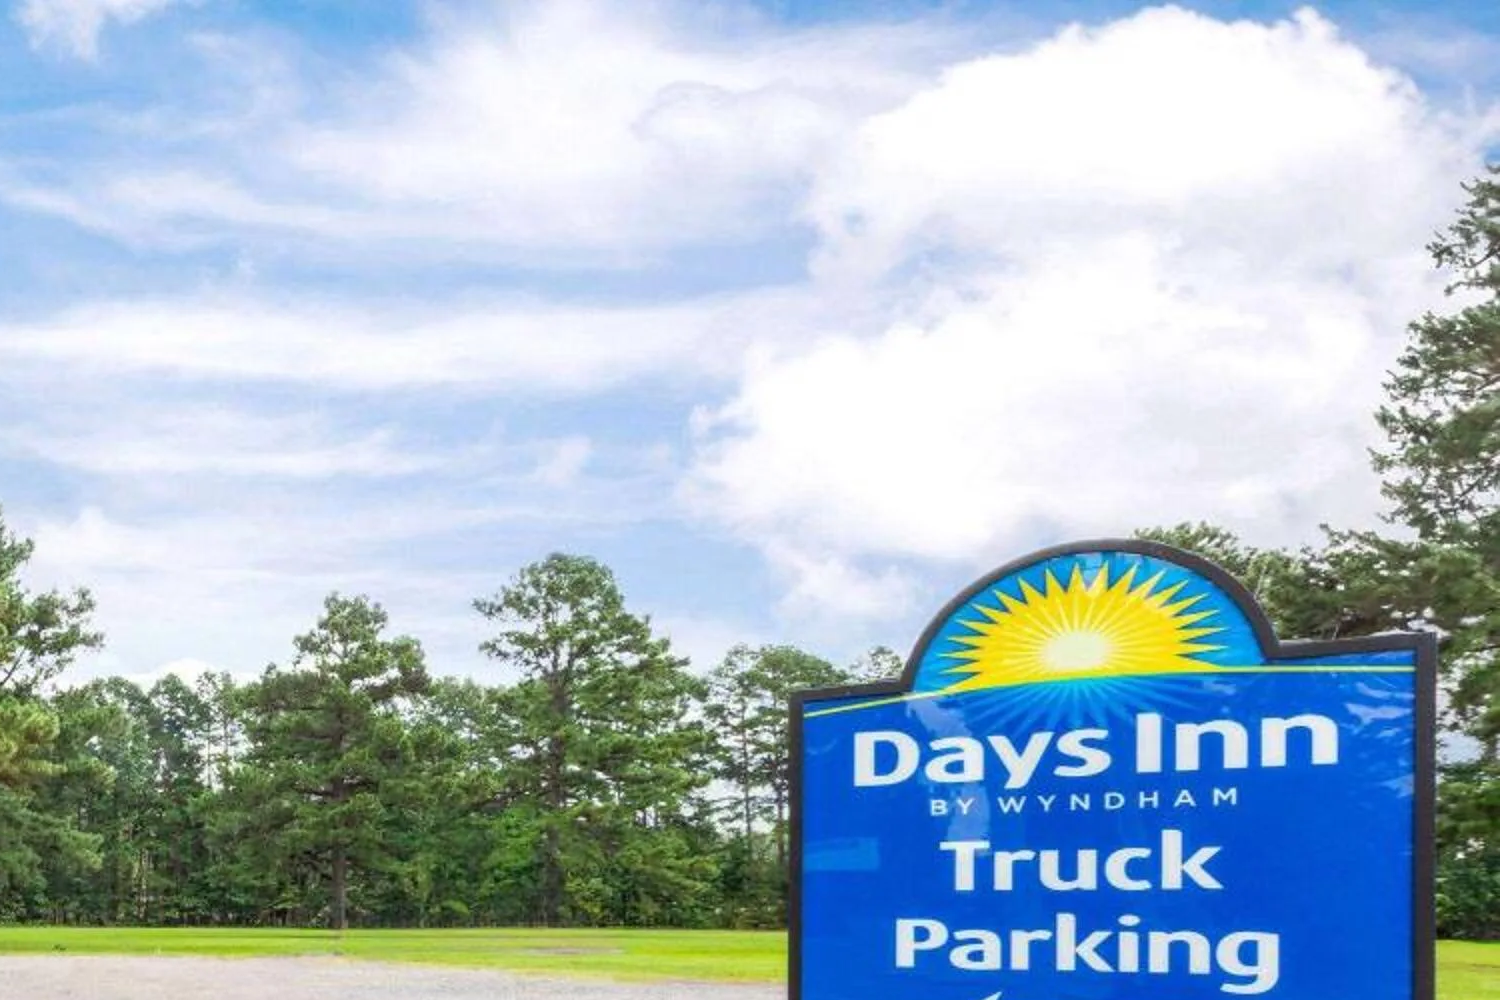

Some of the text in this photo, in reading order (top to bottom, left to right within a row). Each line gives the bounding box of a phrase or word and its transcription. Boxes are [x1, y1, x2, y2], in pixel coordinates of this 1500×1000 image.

[853, 712, 1339, 787] Days Inn
[930, 787, 1238, 816] BY WYNDHAM
[940, 830, 1223, 891] Truck
[895, 913, 1279, 994] Parking
